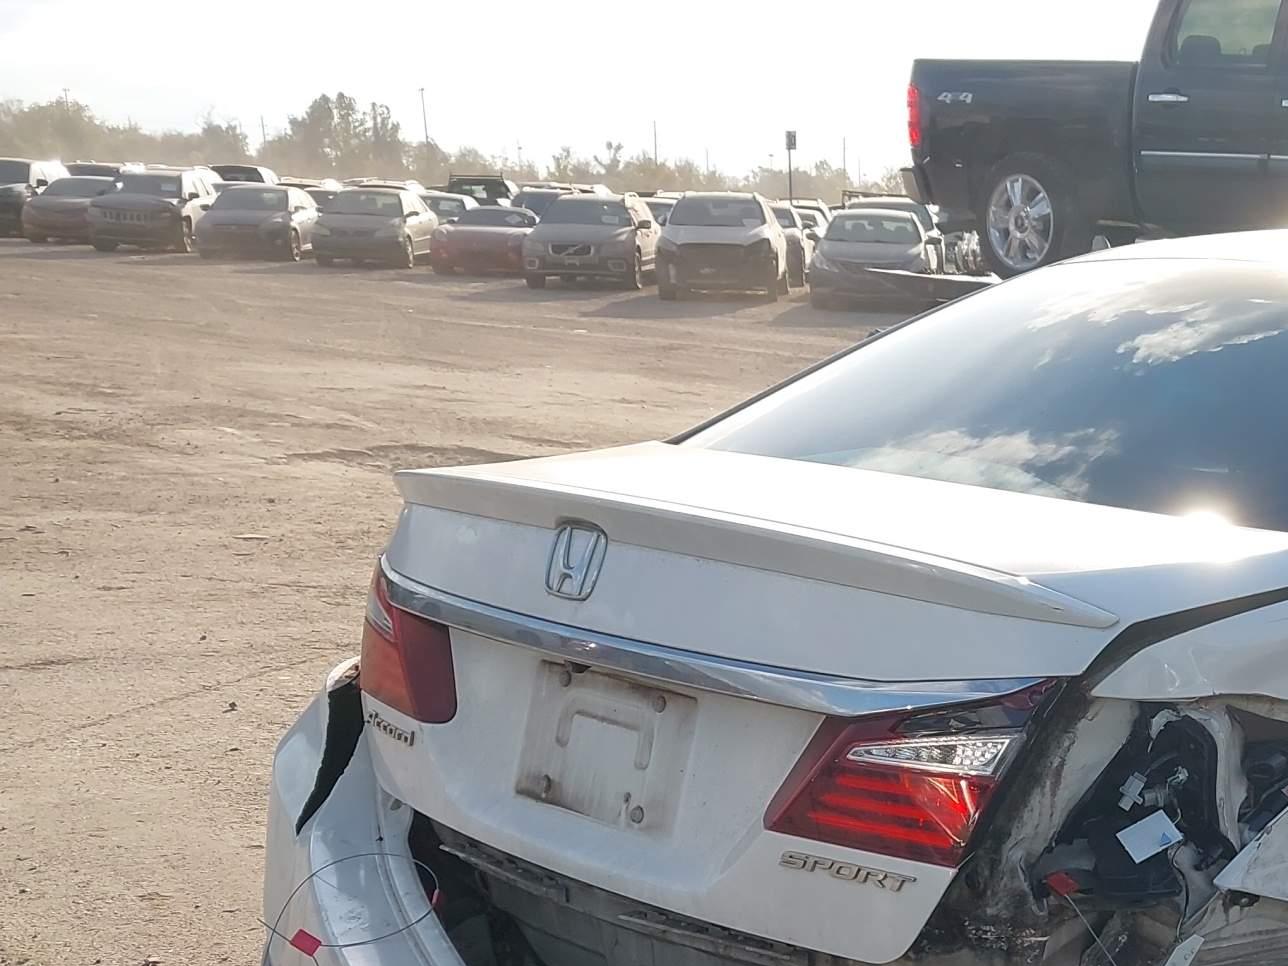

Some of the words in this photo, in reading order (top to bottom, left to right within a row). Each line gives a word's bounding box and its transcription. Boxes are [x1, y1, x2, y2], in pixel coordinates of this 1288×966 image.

[937, 91, 973, 104] 44
[365, 709, 416, 747] Accord
[779, 850, 918, 893] SPORT
